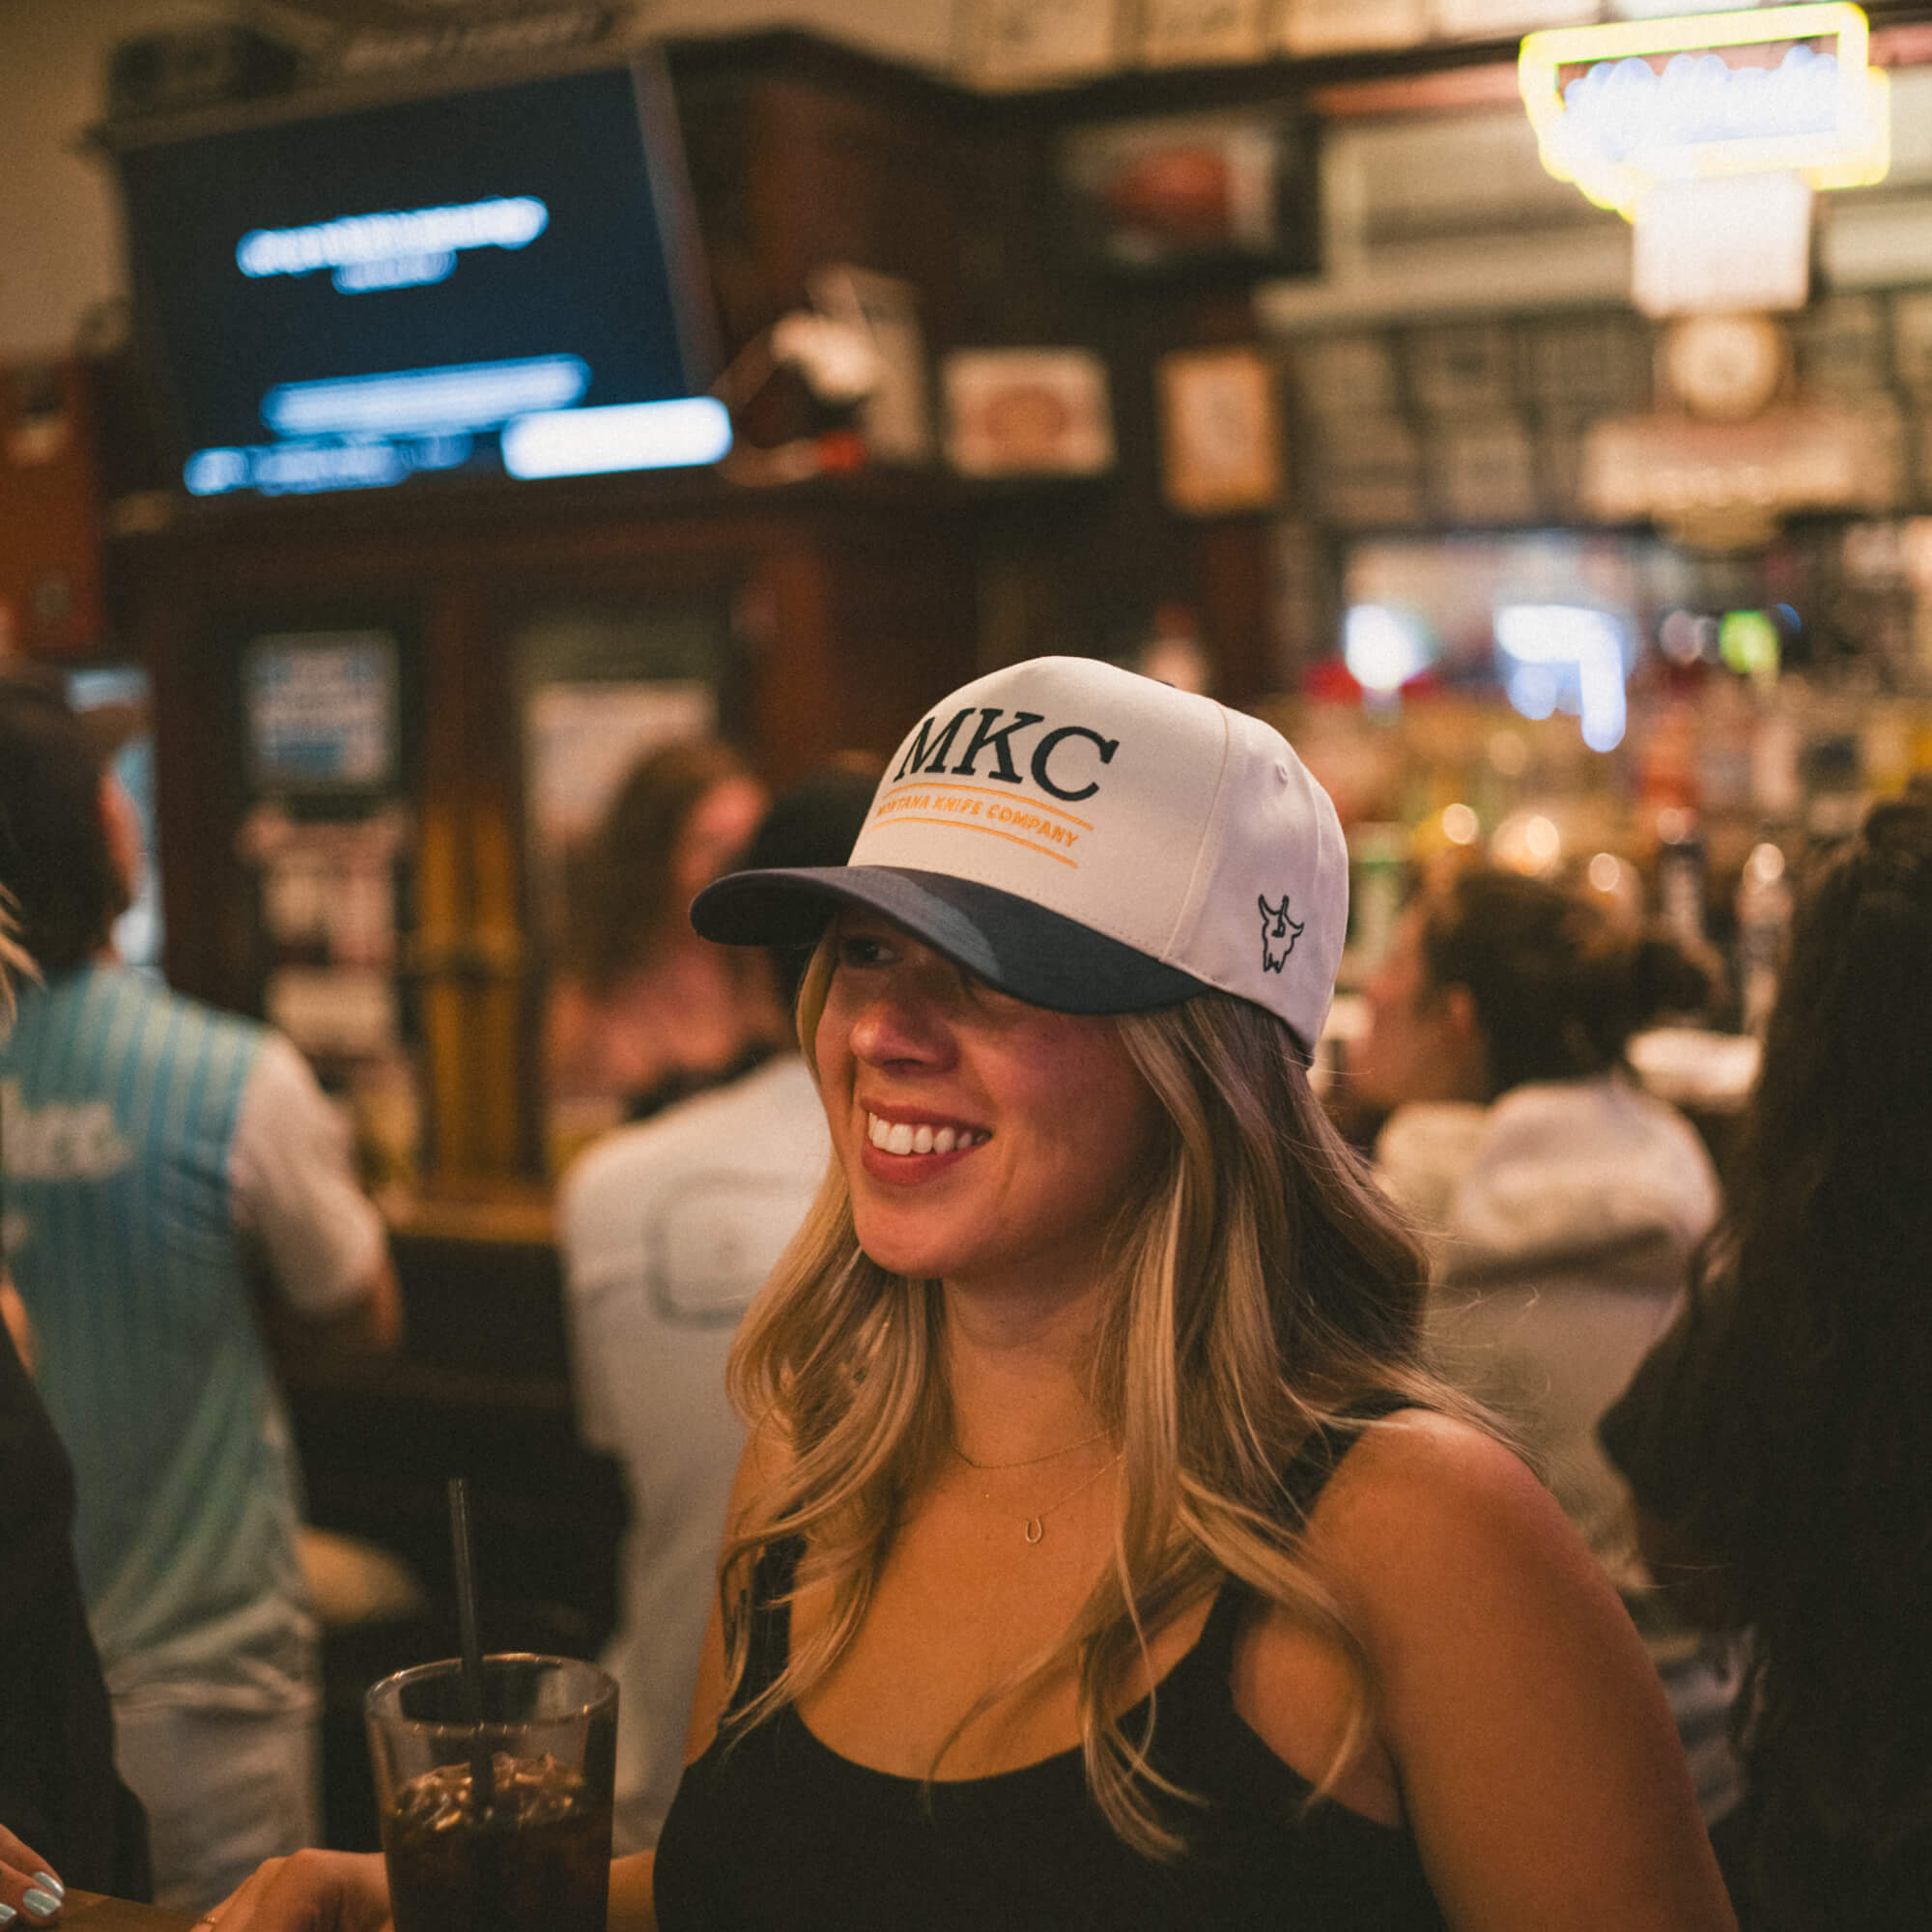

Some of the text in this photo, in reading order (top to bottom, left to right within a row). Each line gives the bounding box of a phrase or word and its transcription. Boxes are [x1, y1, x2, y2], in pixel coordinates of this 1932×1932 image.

[894, 707, 1120, 802] MKC
[932, 796, 983, 815] KNIFE
[986, 805, 1079, 847] COMPANY
